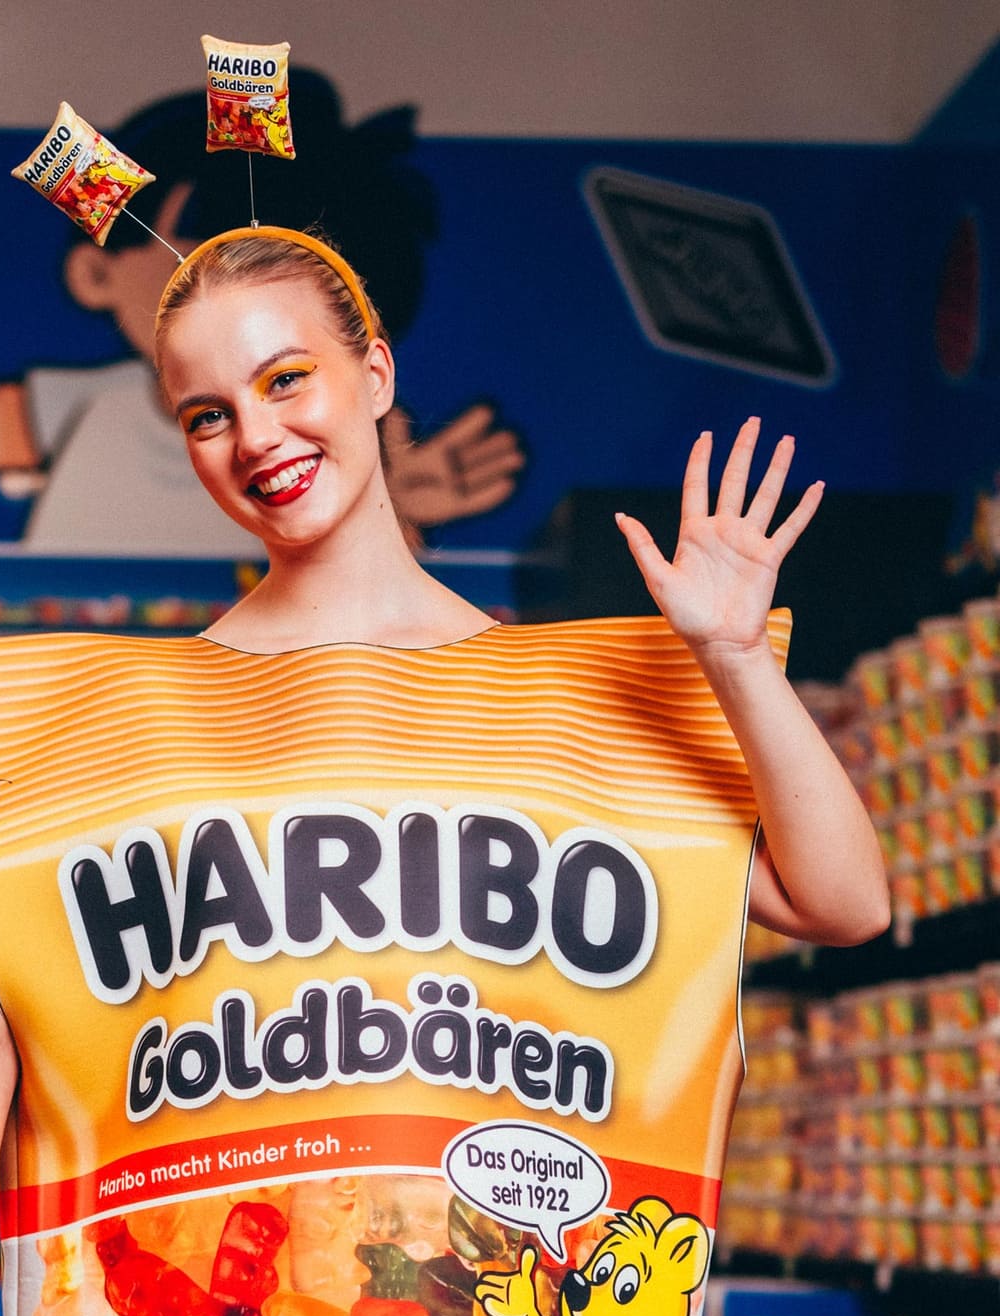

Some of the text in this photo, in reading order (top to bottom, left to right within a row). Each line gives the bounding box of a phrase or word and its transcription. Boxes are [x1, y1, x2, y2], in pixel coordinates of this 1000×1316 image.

[208, 54, 277, 77] HARIBO
[210, 77, 274, 94] Goldbären
[23, 125, 72, 184] HARIBO
[40, 142, 83, 193] Goldbären
[69, 811, 648, 991] HARIBO
[127, 979, 609, 1115] Goldbären
[99, 1170, 146, 1199] Haribo
[150, 1155, 212, 1184] macht
[218, 1143, 288, 1171] Kinder
[294, 1134, 340, 1158] froh
[466, 1143, 583, 1183] Das Original
[491, 1181, 570, 1212] seit 1922
